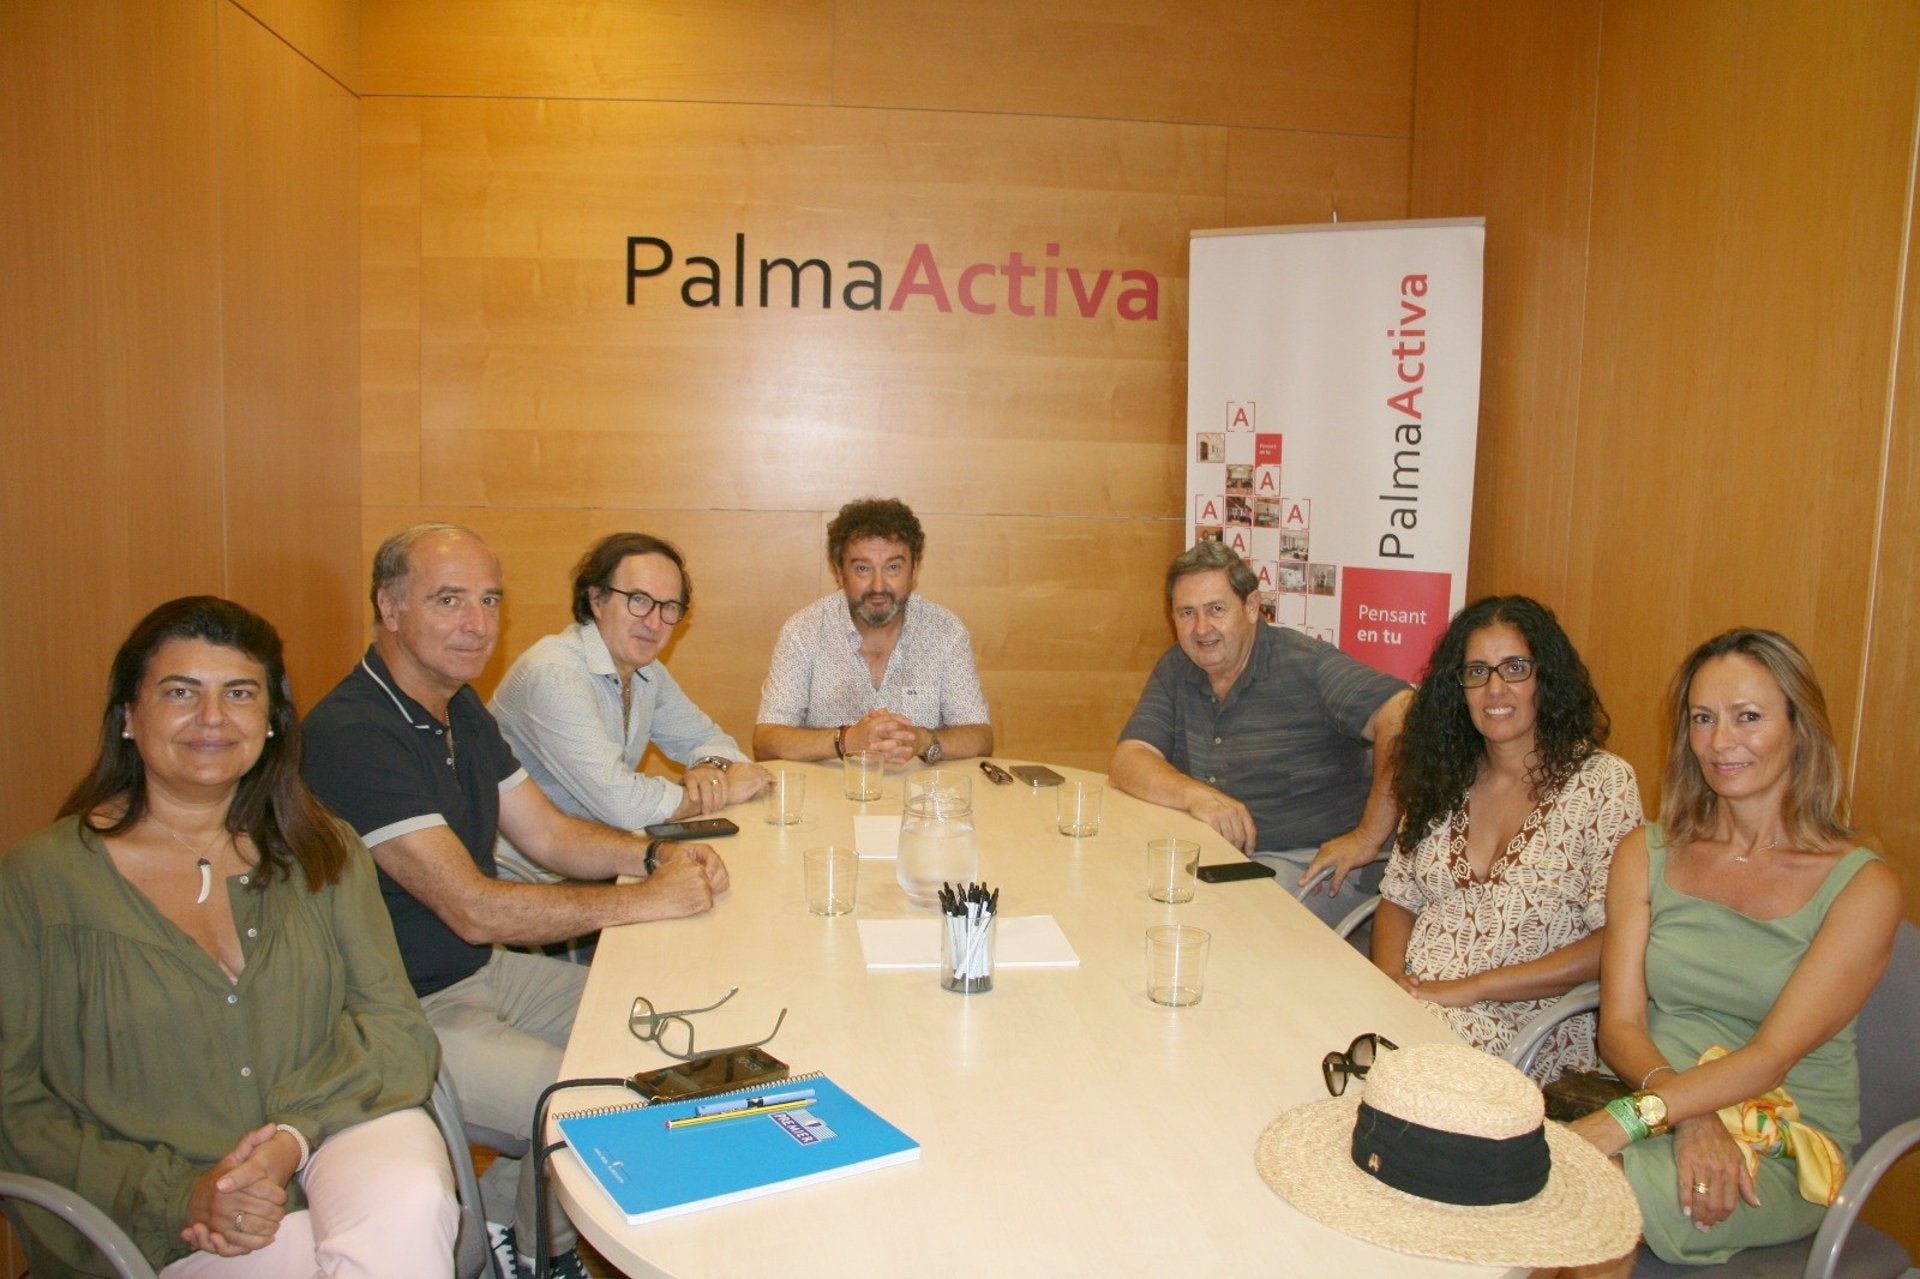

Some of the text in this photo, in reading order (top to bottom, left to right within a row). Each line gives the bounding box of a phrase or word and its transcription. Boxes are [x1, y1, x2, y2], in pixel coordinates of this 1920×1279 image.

[1232, 407, 1249, 427] A
[1378, 273, 1428, 560] PalmaActiva
[1259, 471, 1275, 491] A
[1202, 500, 1218, 520] A
[1287, 504, 1304, 524] A
[1231, 533, 1246, 552] A
[1258, 566, 1272, 586] A
[1358, 604, 1427, 625] Pensant
[1356, 629, 1402, 645] en tu
[773, 1112, 815, 1144] PREMIER
